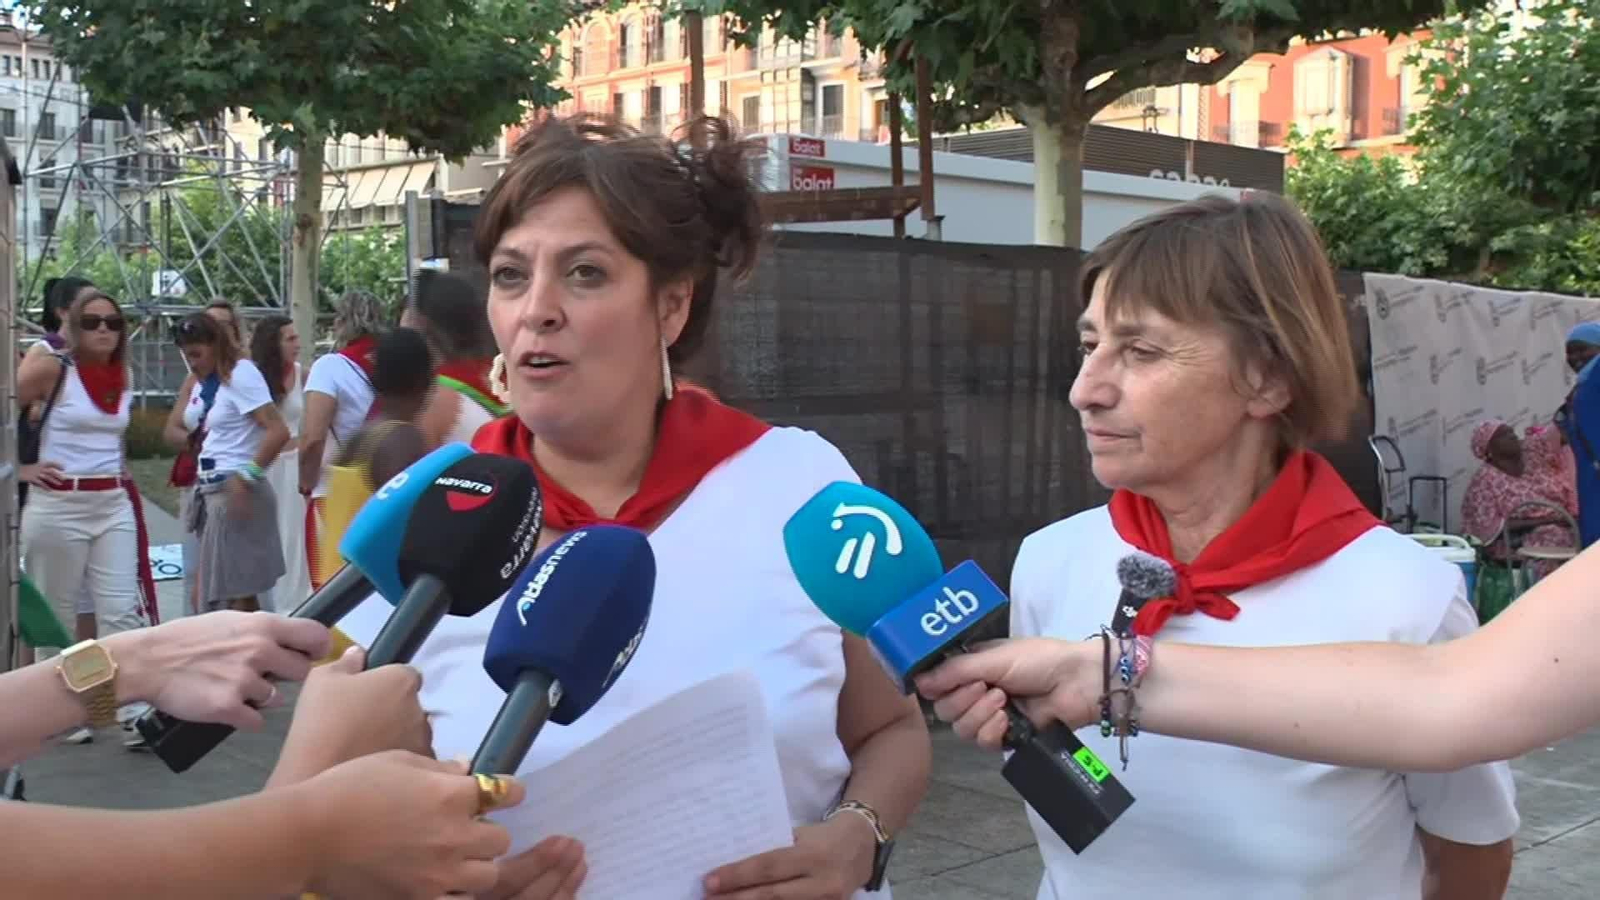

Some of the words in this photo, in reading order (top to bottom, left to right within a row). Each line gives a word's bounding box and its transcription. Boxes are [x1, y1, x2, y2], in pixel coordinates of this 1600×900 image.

[792, 140, 820, 154] balat
[792, 172, 833, 191] balat
[920, 586, 979, 636] etb
